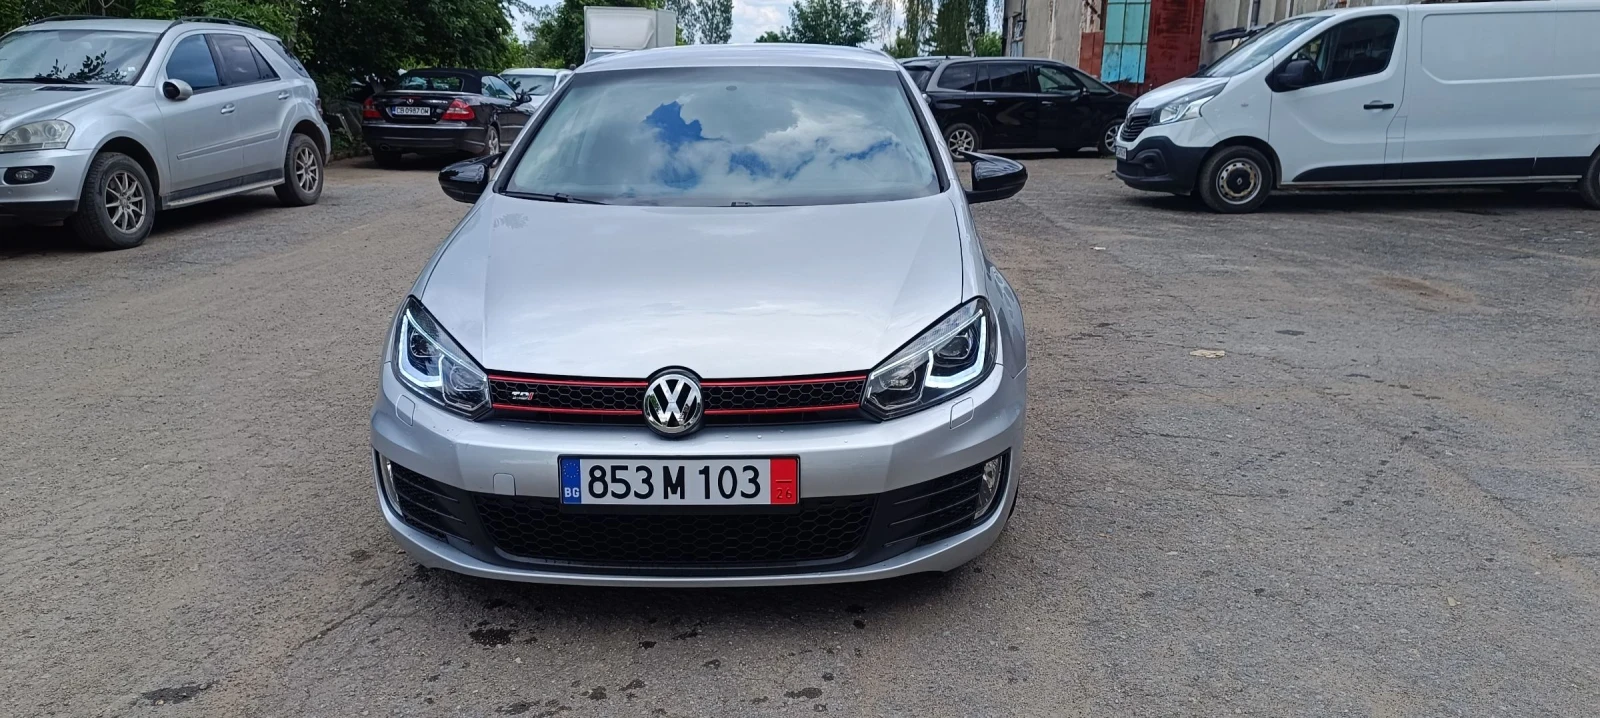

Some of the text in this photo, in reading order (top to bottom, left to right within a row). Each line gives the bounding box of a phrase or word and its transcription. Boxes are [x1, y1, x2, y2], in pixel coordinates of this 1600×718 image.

[588, 465, 761, 500] 853 M 103
[564, 487, 580, 498] BG
[776, 487, 793, 499] 26
